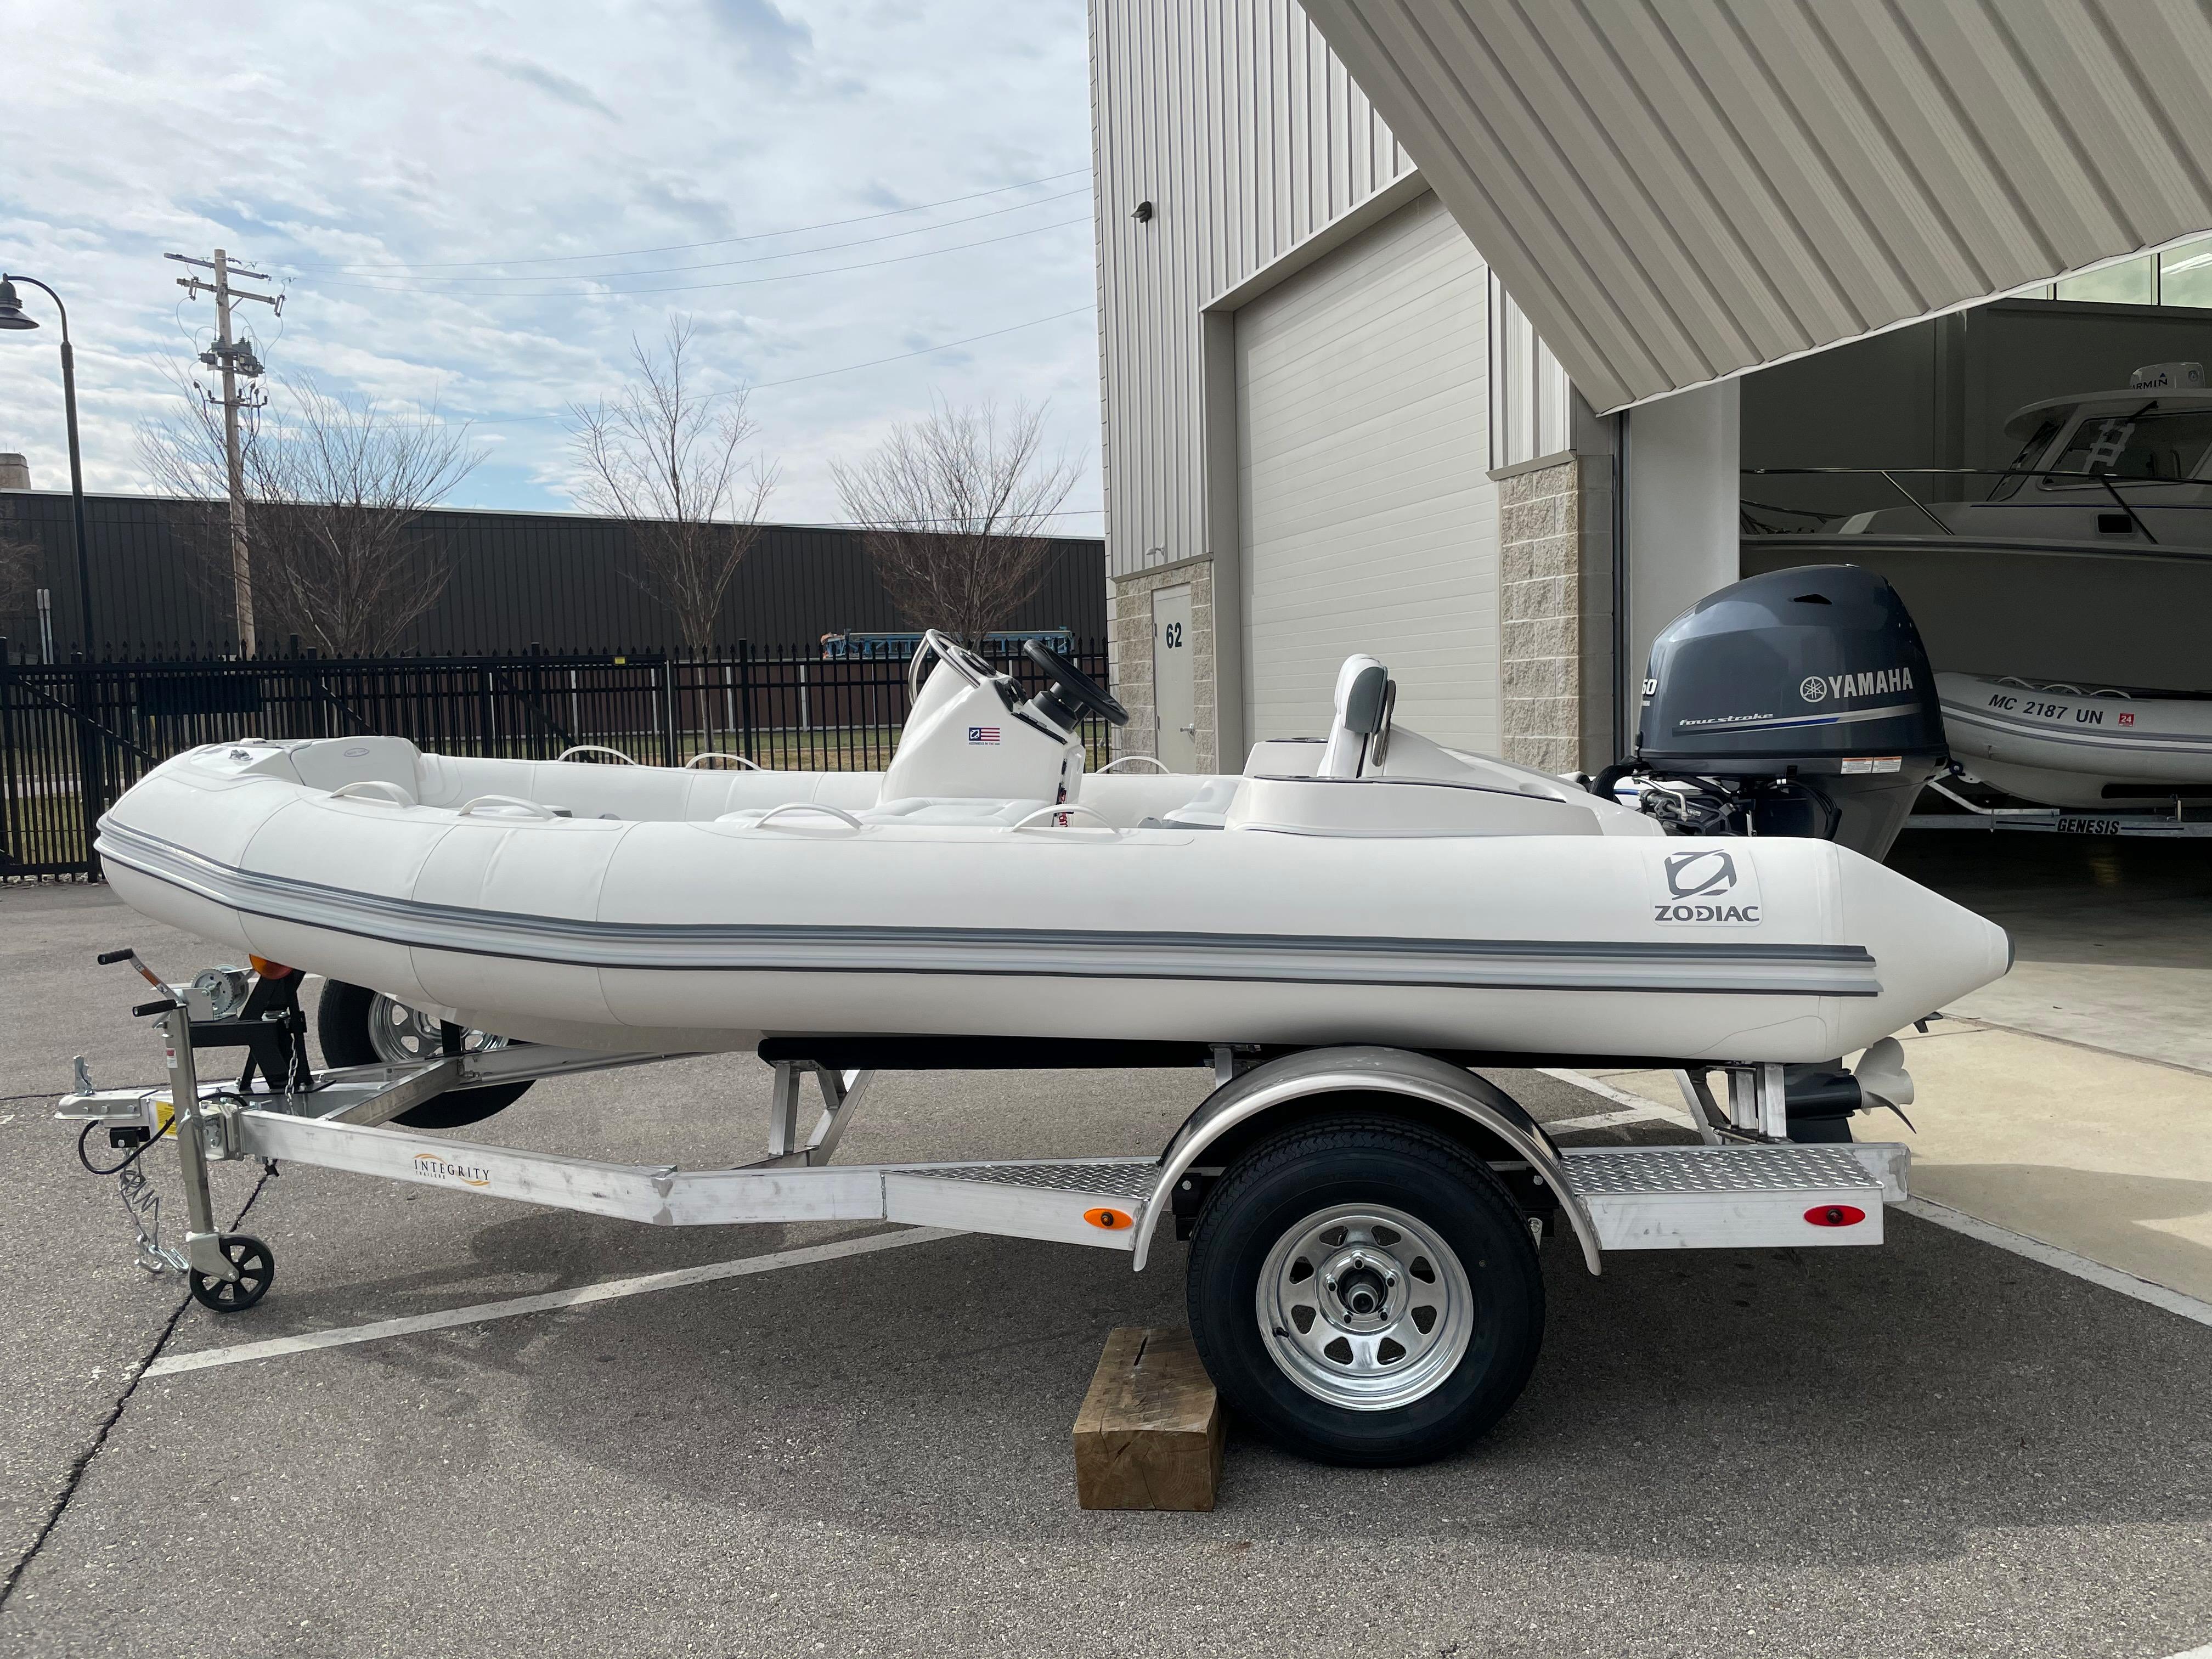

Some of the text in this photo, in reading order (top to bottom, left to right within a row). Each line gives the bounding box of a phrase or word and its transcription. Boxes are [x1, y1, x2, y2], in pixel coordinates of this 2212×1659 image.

[1166, 622, 1182, 648] 62
[1641, 679, 1657, 695] 60
[1828, 667, 1914, 698] YAMAHA
[1988, 694, 2103, 724] MC 2187 UN
[2057, 818, 2120, 834] GENESIS
[1655, 905, 1759, 922] ZODIAC
[414, 1159, 489, 1181] INTEGRITY
